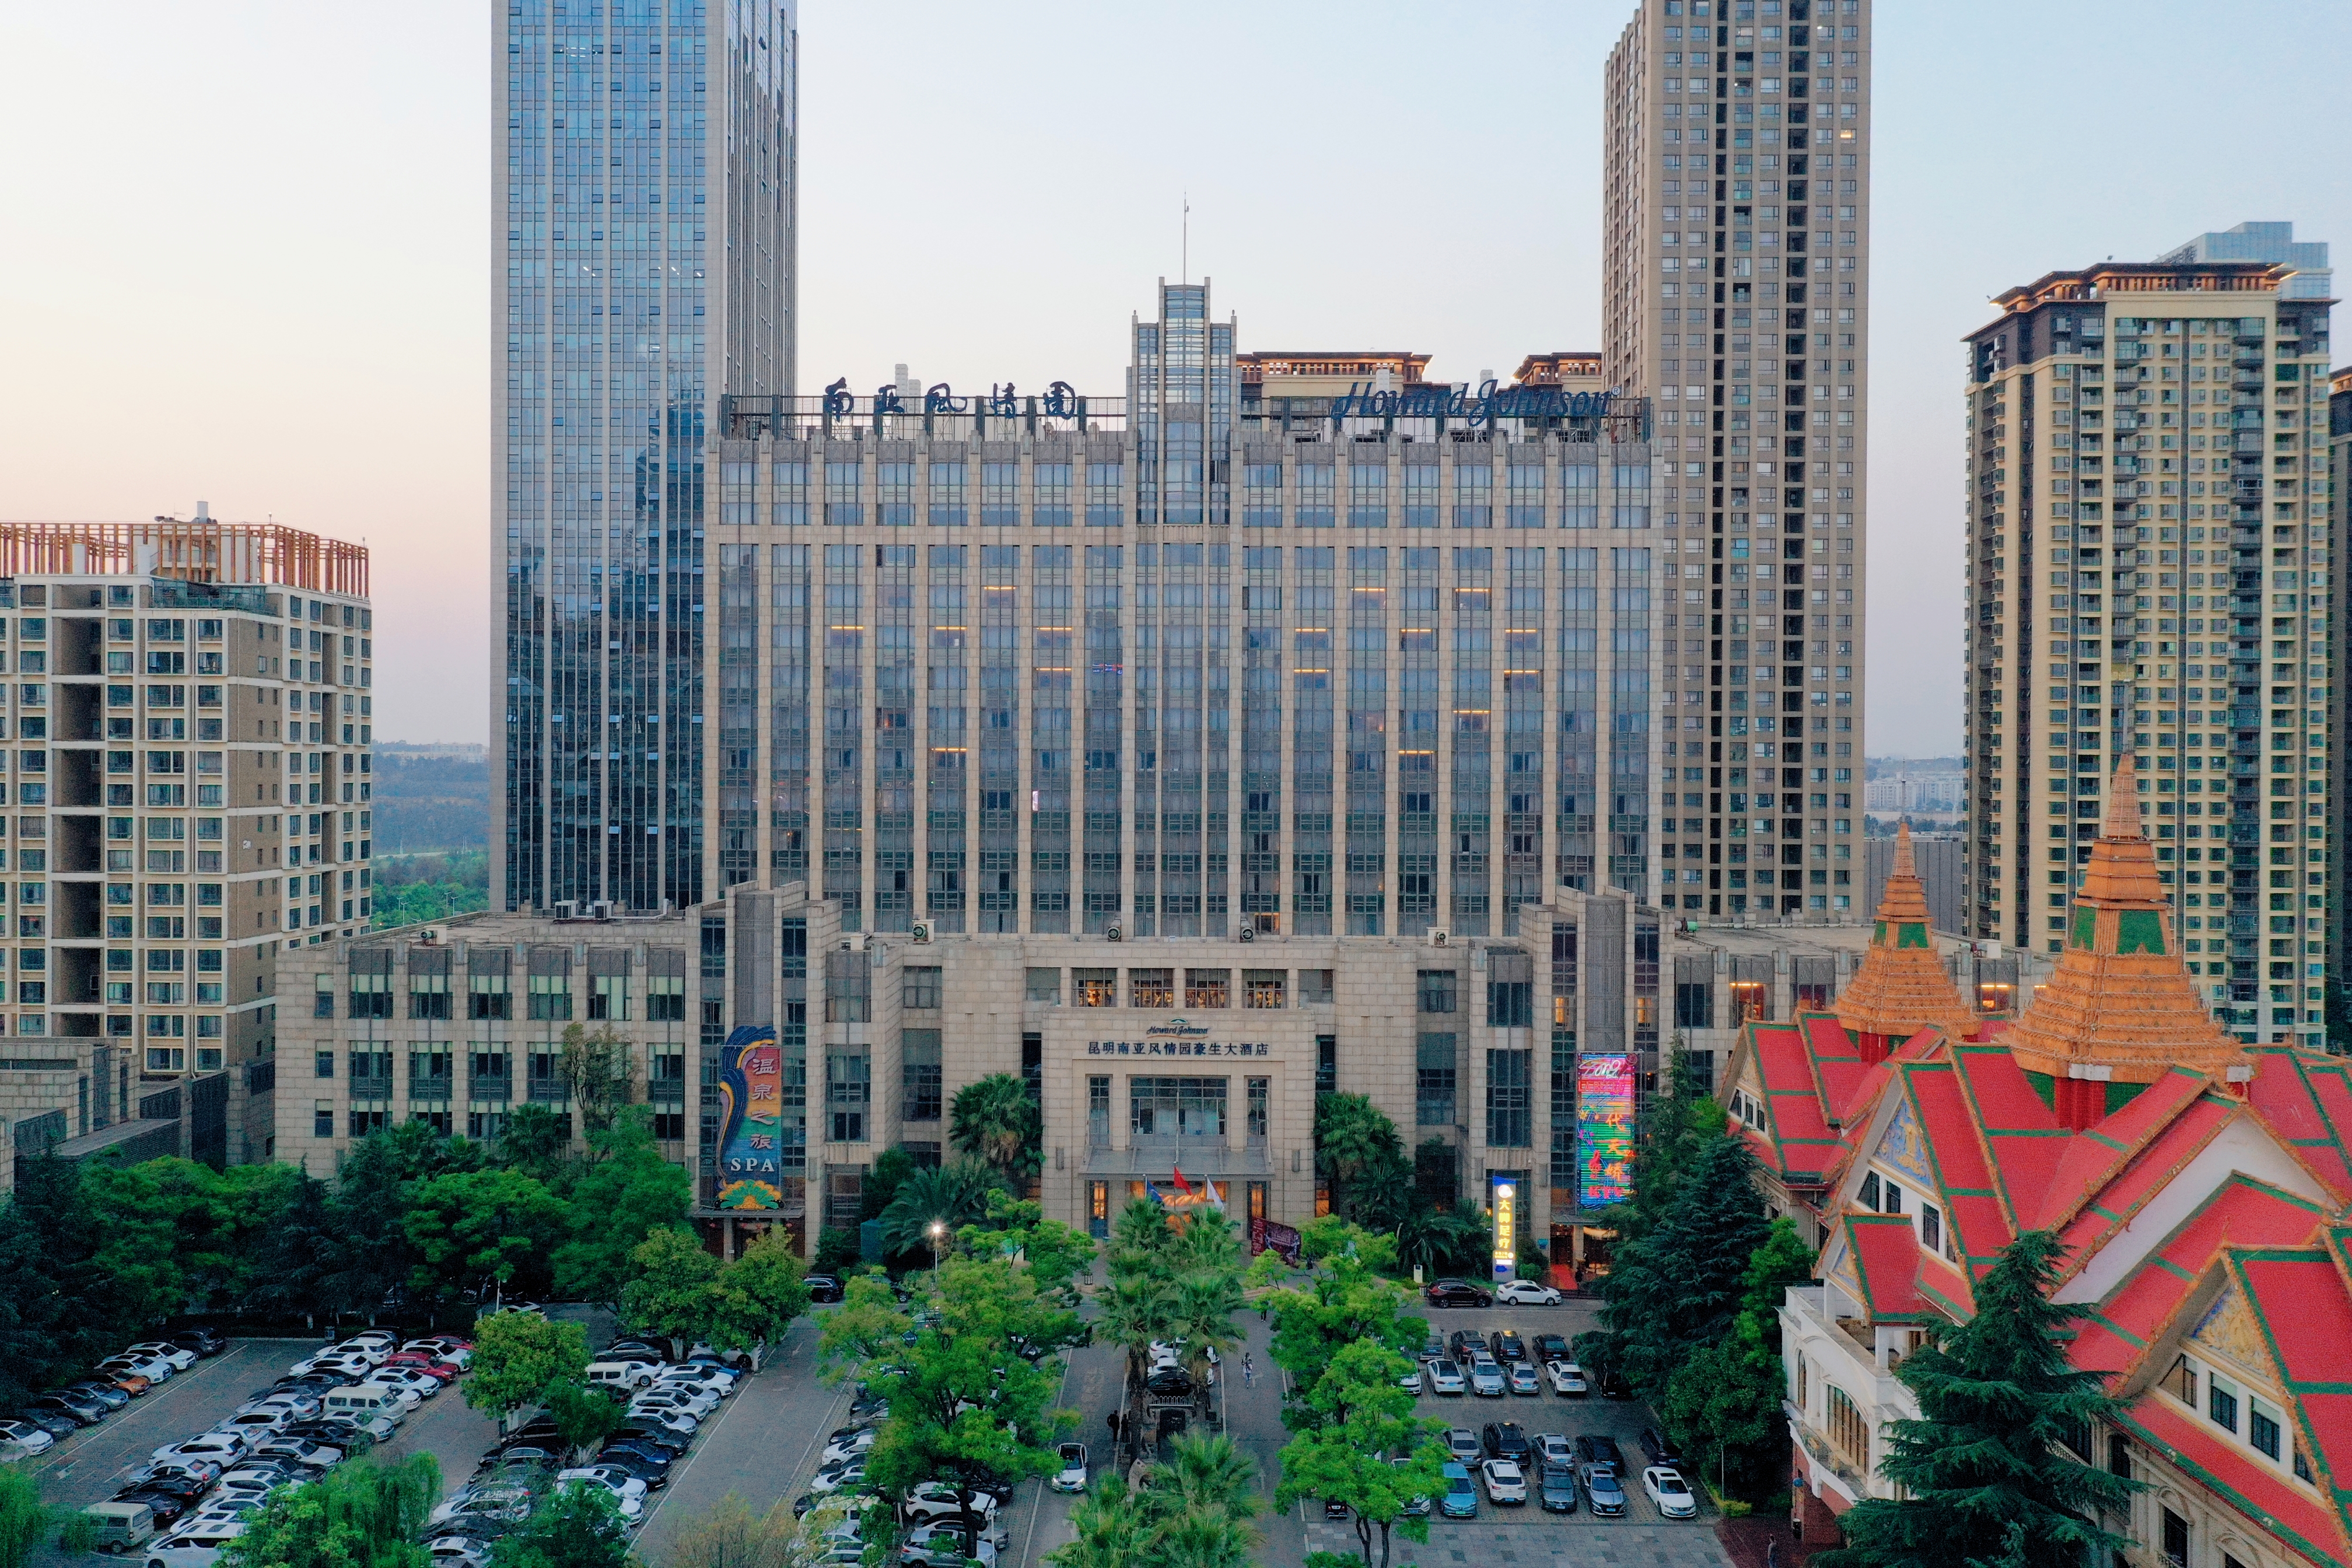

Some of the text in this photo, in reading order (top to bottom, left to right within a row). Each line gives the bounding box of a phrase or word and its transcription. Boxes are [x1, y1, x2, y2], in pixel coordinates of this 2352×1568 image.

[1331, 382, 1469, 419] Howard
[1468, 379, 1611, 426] Johnson
[1146, 1026, 1209, 1036] Howard Johnson
[1088, 1041, 1269, 1056] 昆明南亚风情园豪生大酒店
[750, 1058, 777, 1149] 温泉之旅
[730, 1157, 775, 1172] SPA
[1588, 1186, 1624, 1199] KTV
